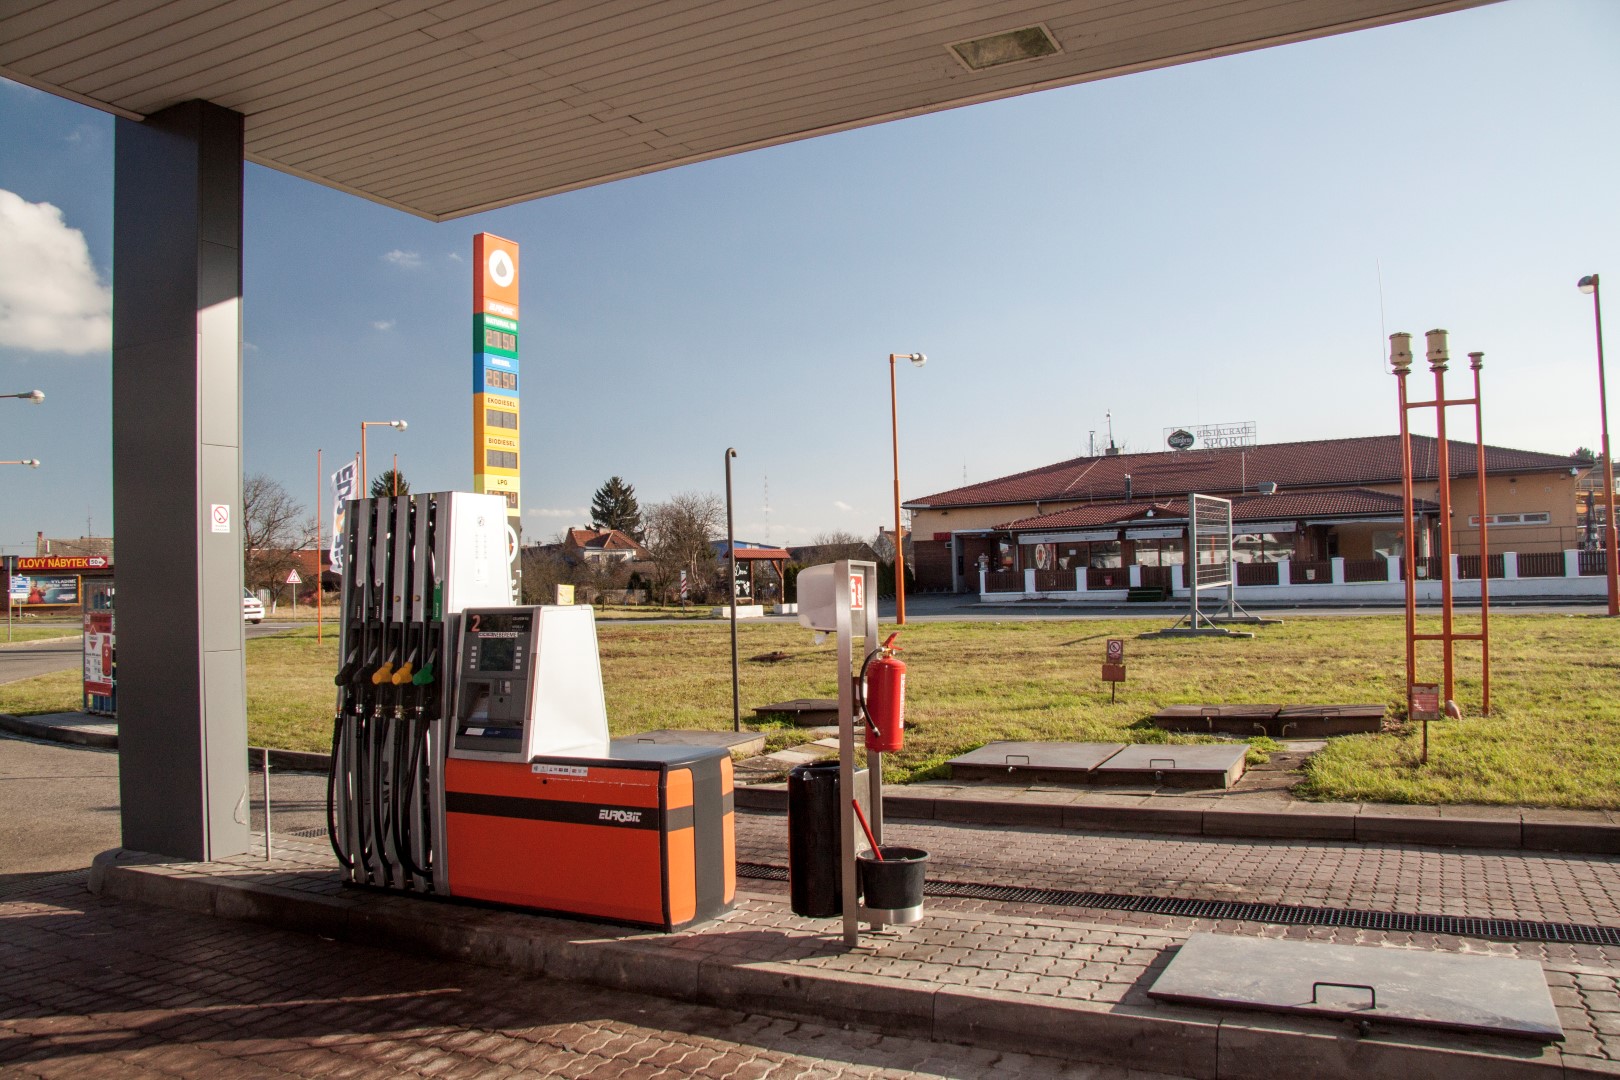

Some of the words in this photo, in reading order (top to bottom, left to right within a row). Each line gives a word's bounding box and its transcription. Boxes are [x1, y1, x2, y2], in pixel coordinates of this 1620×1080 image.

[487, 397, 516, 407] EKODIESEL
[1196, 427, 1253, 438] RESTAURACE
[488, 438, 516, 446] BIODIESEL
[1203, 436, 1246, 448] SPORT
[48, 557, 88, 568] NÁBYTEK
[471, 614, 480, 632] 2
[599, 809, 642, 822] EUROBIT
